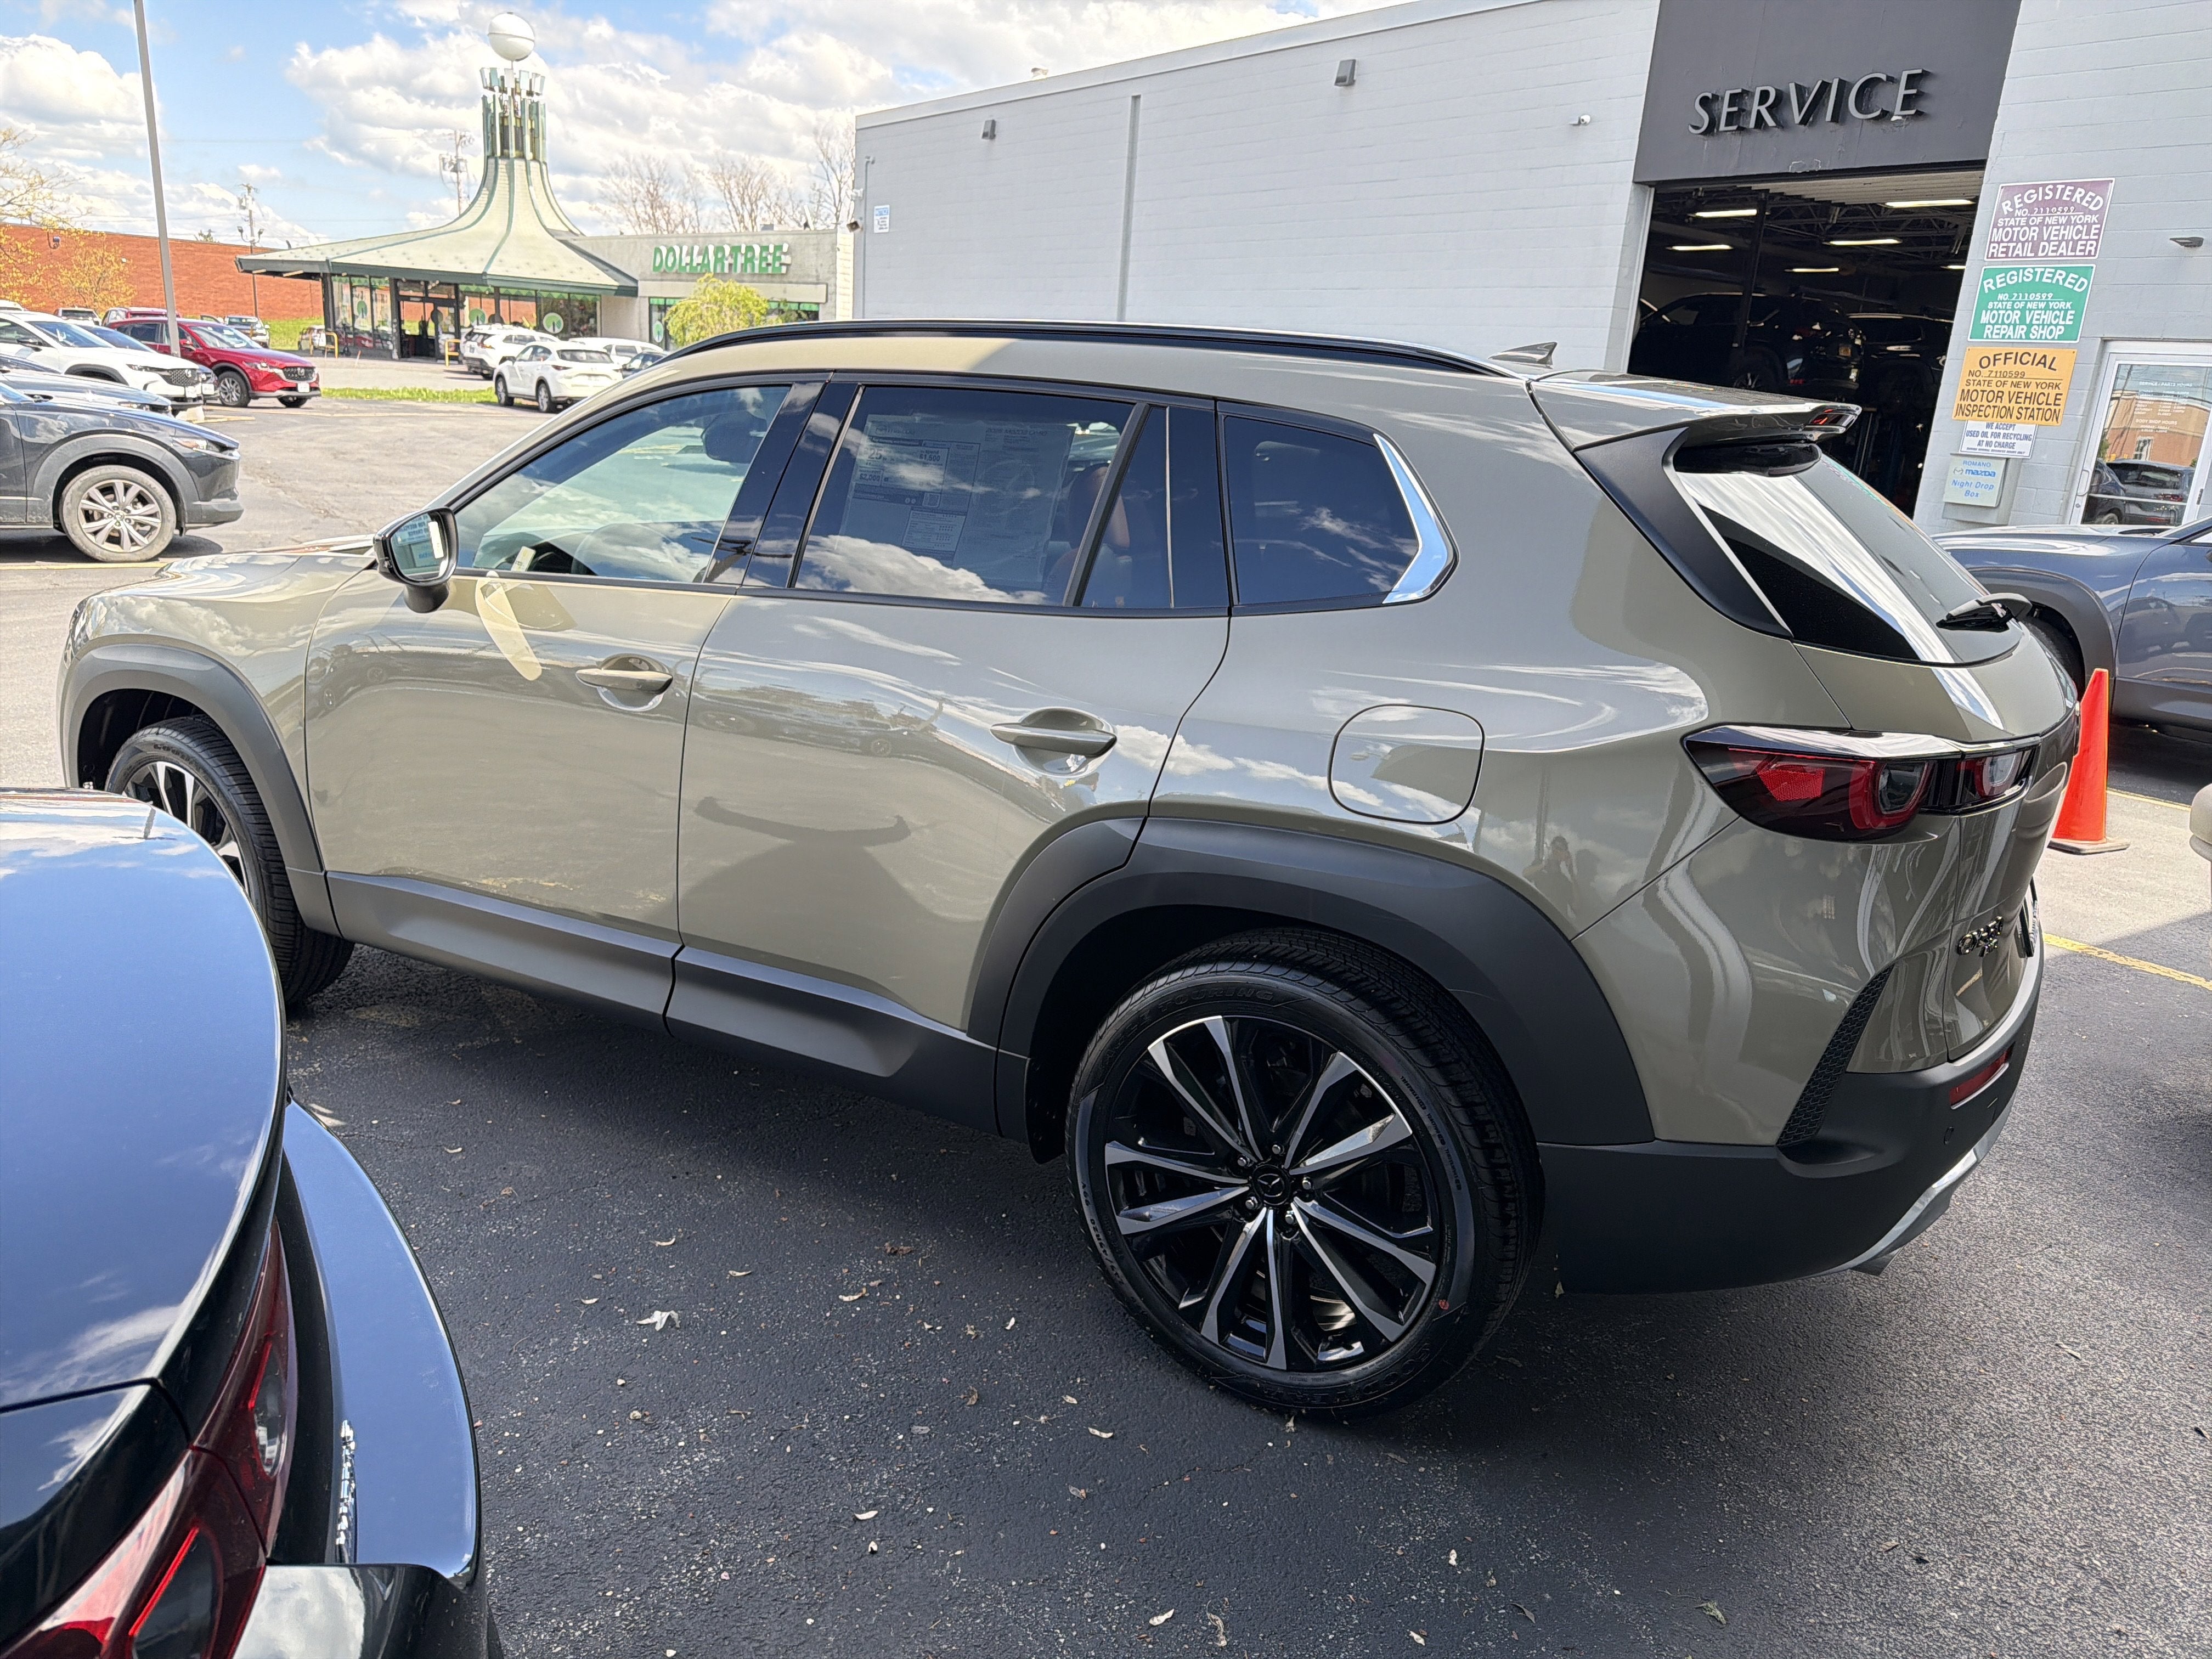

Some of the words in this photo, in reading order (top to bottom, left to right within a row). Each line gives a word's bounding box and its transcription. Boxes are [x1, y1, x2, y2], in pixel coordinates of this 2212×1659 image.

[1688, 69, 1924, 134] SERVICE
[2001, 184, 2103, 215] REGISTERED
[2034, 206, 2076, 215] 7110599
[1997, 218, 2028, 227] STATE
[2029, 217, 2043, 225] OF
[2045, 216, 2069, 225] NEW
[2070, 214, 2099, 223] YORK
[1991, 227, 2039, 241] MOTOR
[2043, 224, 2101, 240] VEHICLE
[1988, 241, 2035, 258] RETAIL
[2038, 240, 2097, 257] DEALER
[652, 244, 729, 273] DOLLAR
[731, 244, 787, 273] TREE
[1983, 268, 2088, 294] REGISTERED
[2012, 292, 2053, 301] 7110599
[1980, 310, 2021, 324] MOTOR
[2025, 310, 2075, 325] VEHICLE
[1983, 325, 2027, 339] REPAIR
[2029, 325, 2065, 340] SHOP
[1979, 352, 2057, 371] OFFICIAL
[1965, 379, 1993, 387] STATE
[1995, 380, 2008, 388] OF
[2010, 381, 2032, 389] NEW
[2035, 381, 2062, 390] YORK
[1959, 388, 2004, 404] MOTOR
[2008, 391, 2063, 407] VEHICLE
[1954, 403, 2015, 420] INSPECTION
[2016, 406, 2061, 424] STATION
[1995, 422, 2016, 431] ACCEPT
[2002, 432, 2033, 441] RECYCLING
[1994, 441, 2016, 449] CHARGE
[1951, 479, 1973, 488] Night
[1975, 481, 1994, 491] Drop
